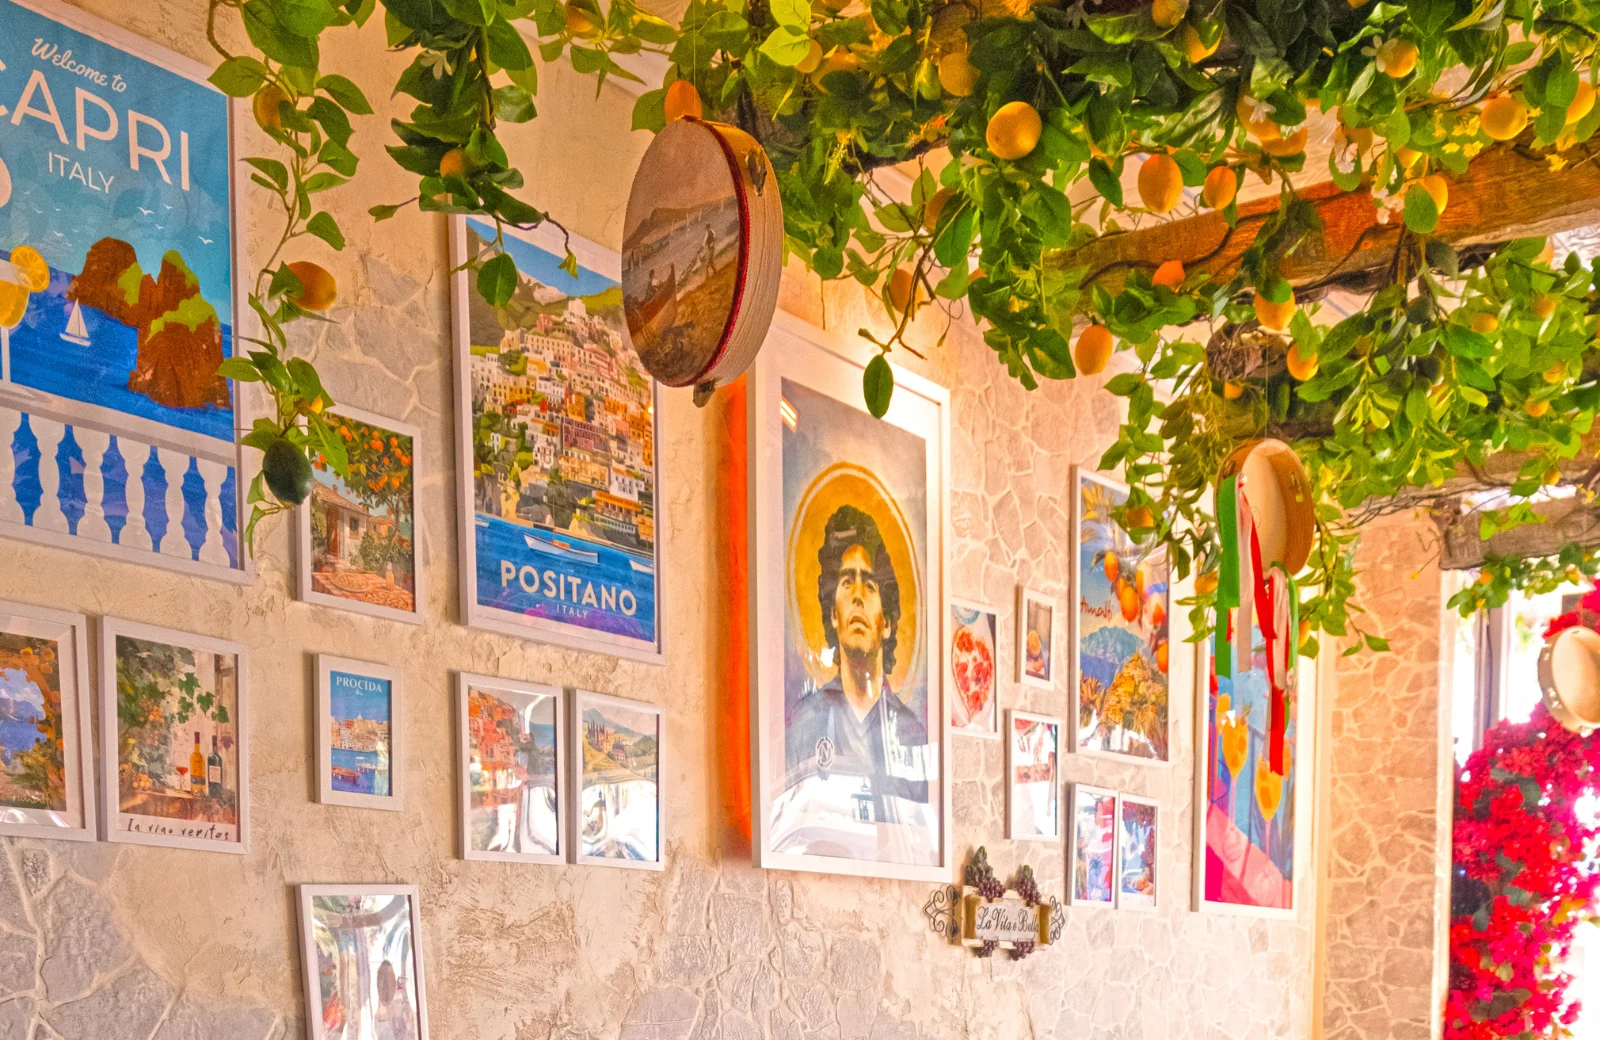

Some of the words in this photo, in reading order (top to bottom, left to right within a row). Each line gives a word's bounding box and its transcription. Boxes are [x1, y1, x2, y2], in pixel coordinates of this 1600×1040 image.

[31, 38, 108, 86] Welcome
[112, 73, 127, 93] to
[0, 59, 190, 192] APRI
[48, 151, 115, 194] ITALY
[500, 559, 637, 616] POSITANO
[556, 603, 588, 619] ITALY
[336, 675, 382, 693] PROCIDA
[127, 818, 140, 832] In
[148, 824, 173, 835] vino
[182, 824, 229, 840] veritas
[976, 905, 992, 931] La
[991, 907, 1012, 932] Vita
[1018, 908, 1040, 933] Bella
